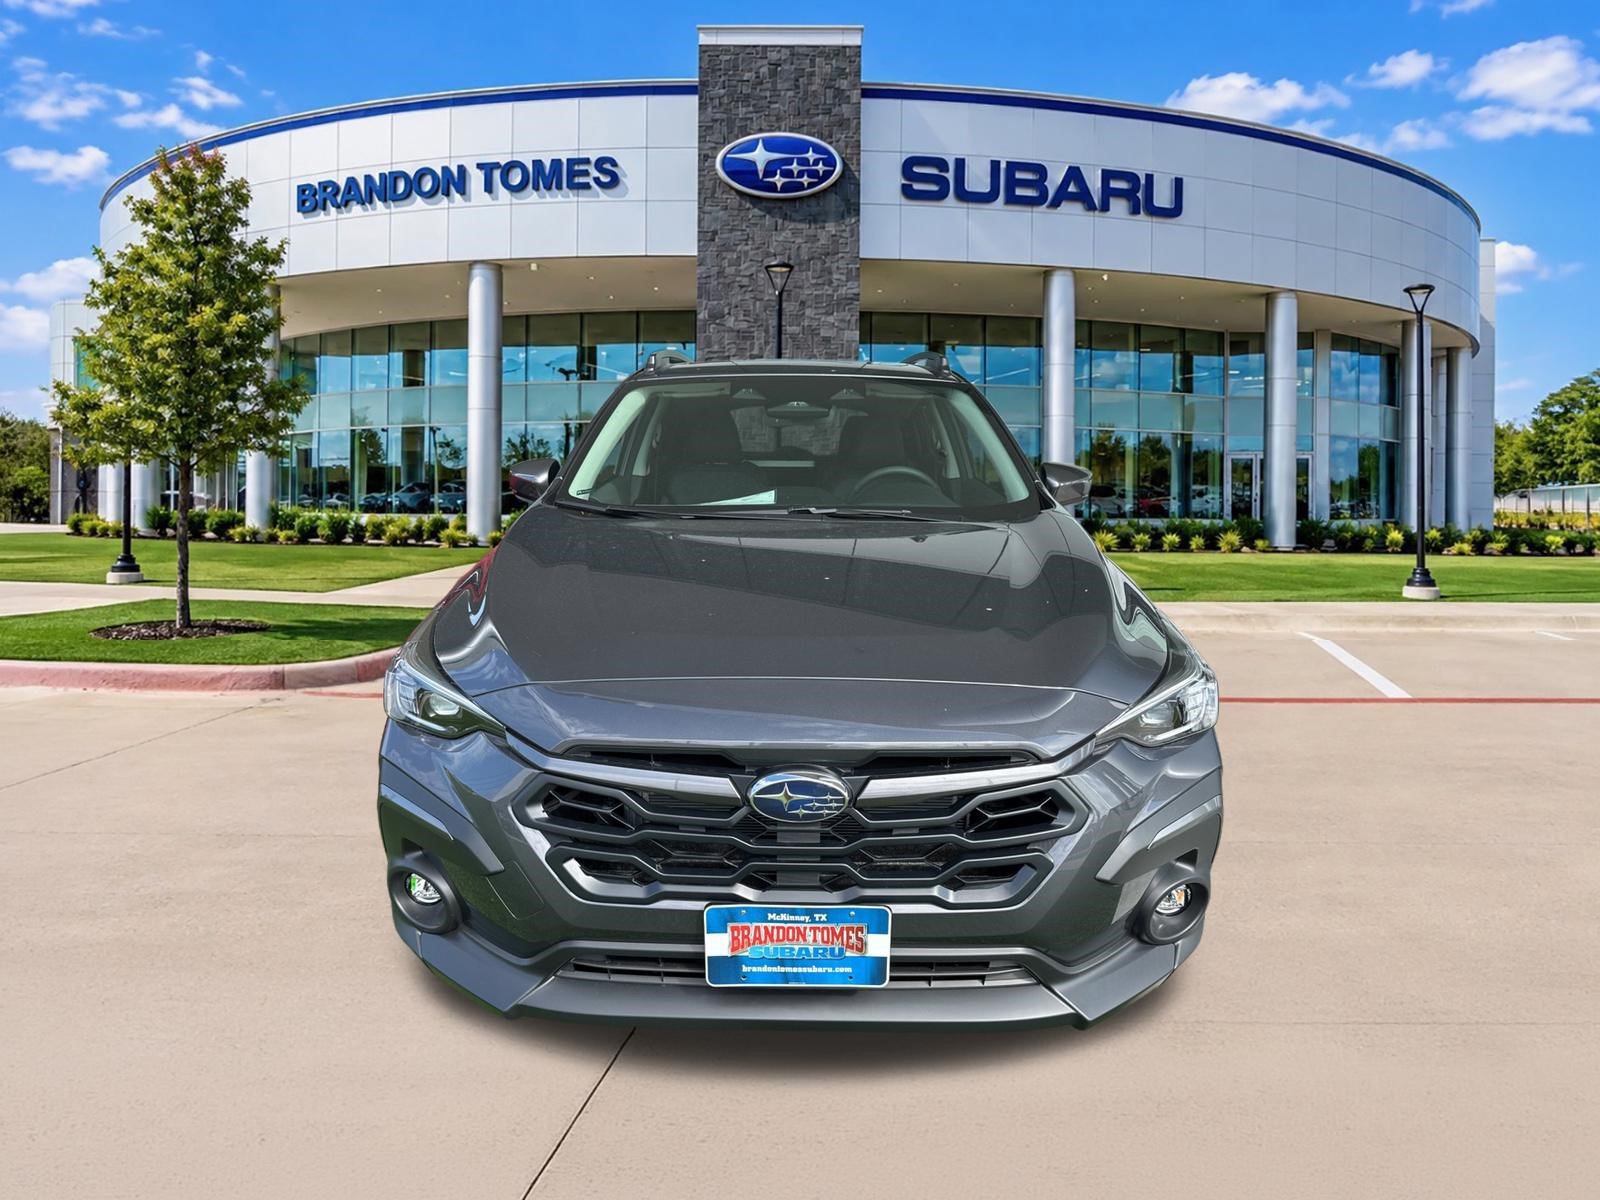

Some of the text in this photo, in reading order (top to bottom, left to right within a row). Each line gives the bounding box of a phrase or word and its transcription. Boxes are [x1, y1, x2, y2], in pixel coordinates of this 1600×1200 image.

[297, 156, 621, 213] BRANDON TOMES
[901, 155, 1183, 218] SUBARU
[814, 913, 828, 922] TX
[730, 925, 864, 953] BRANDON TOMES
[749, 946, 846, 959] SUBARU
[742, 964, 852, 973] brandontomessubaru.com
